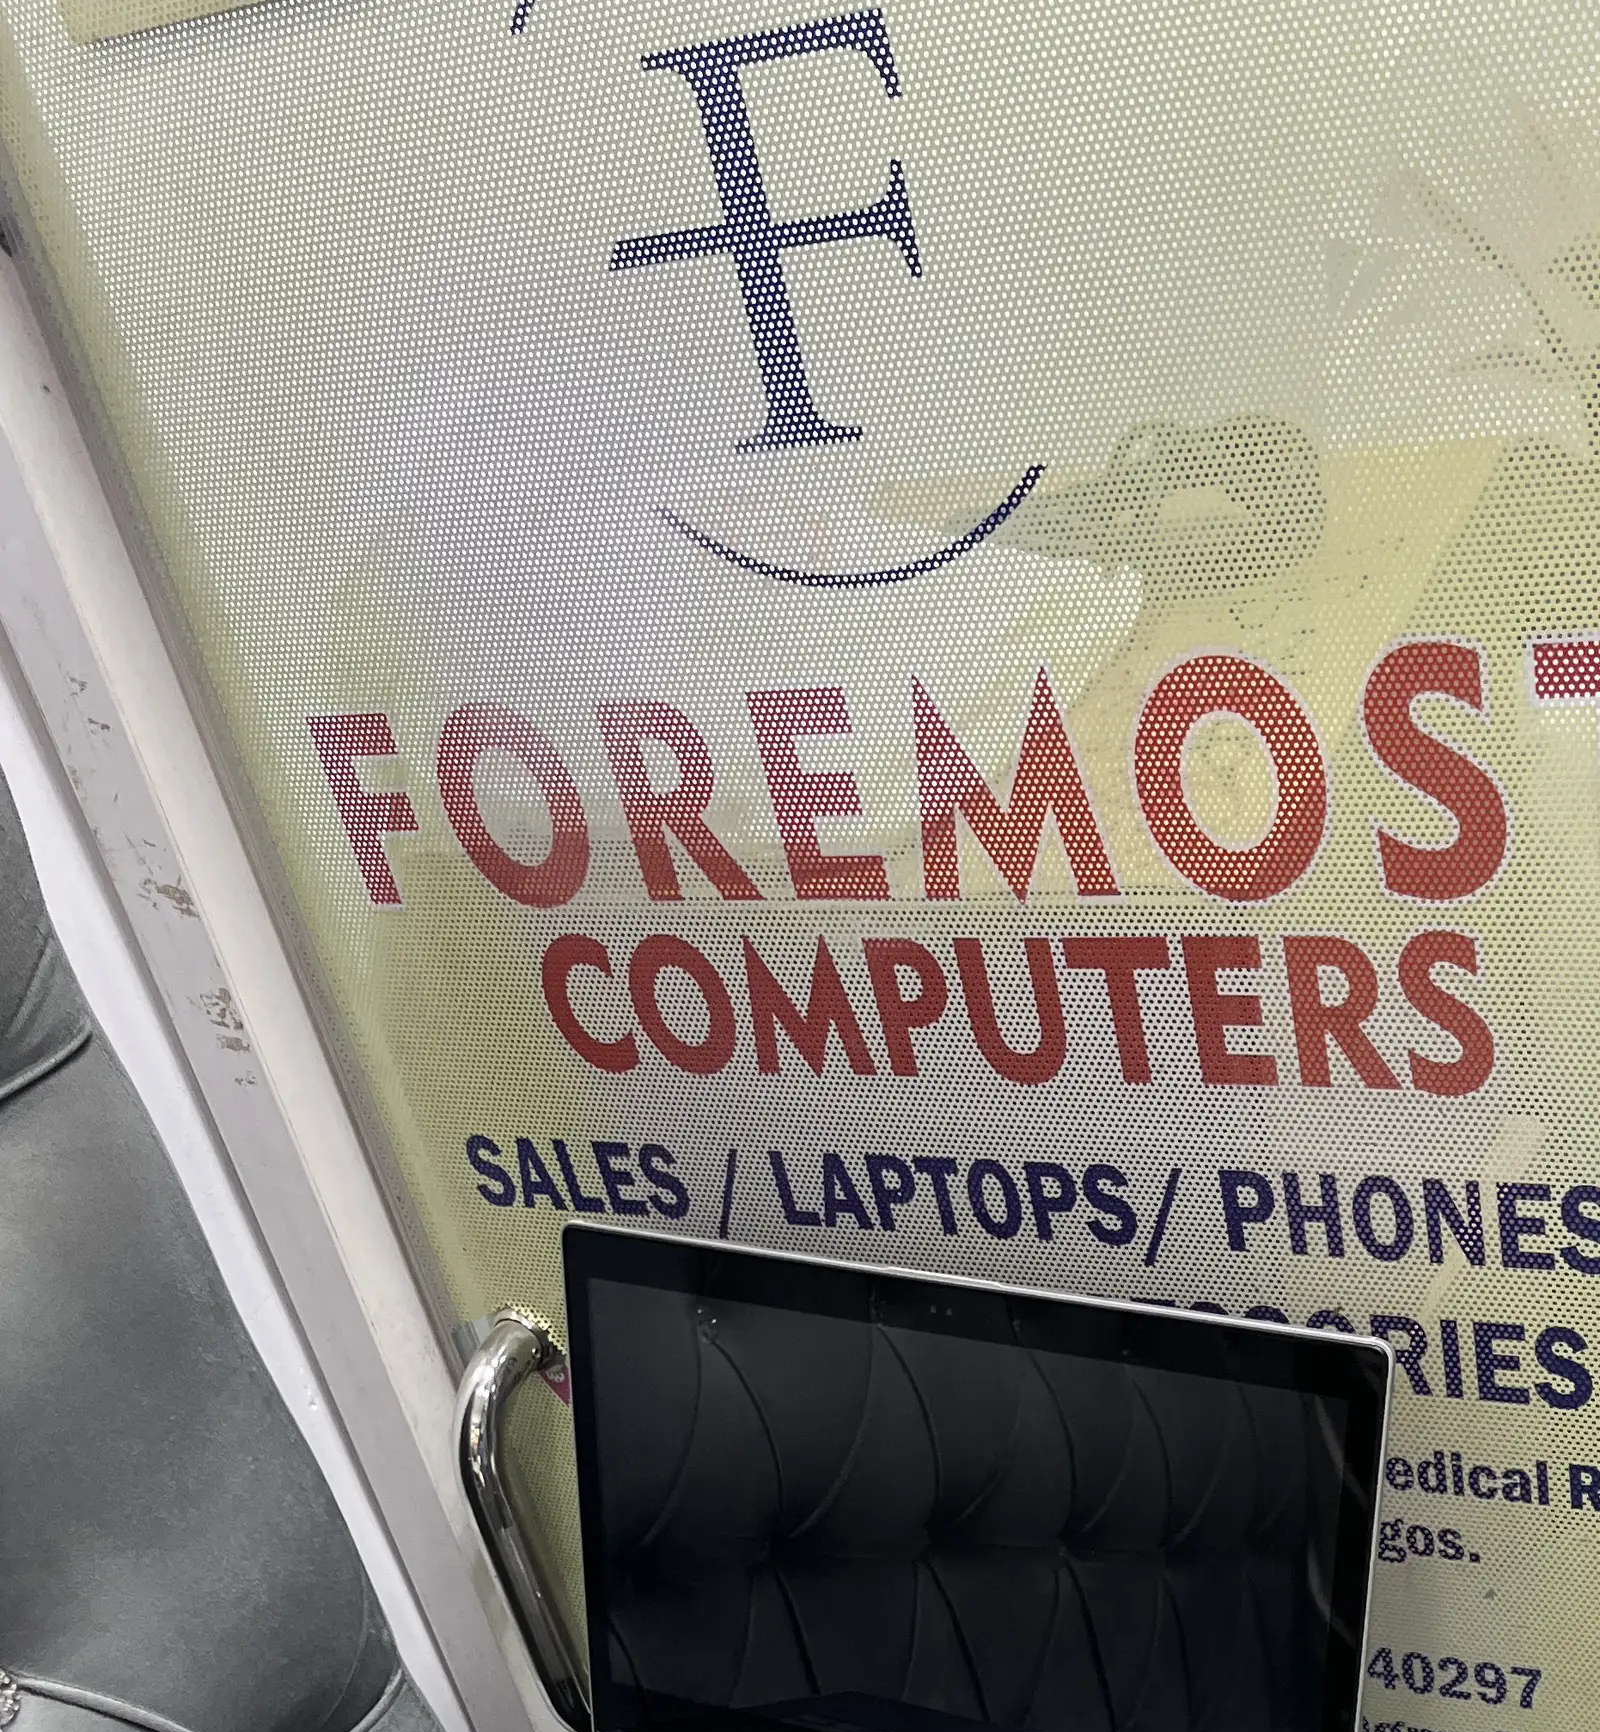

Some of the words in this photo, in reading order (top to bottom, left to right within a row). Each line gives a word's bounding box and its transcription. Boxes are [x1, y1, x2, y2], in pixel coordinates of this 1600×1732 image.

[541, 929, 1494, 1097] COMPUTERS
[466, 1133, 691, 1219] SALES
[1217, 1168, 1600, 1275] PHONES
[1385, 1450, 1549, 1506] edical
[1377, 1518, 1481, 1563] gos.
[1367, 1647, 1542, 1710] 40297
